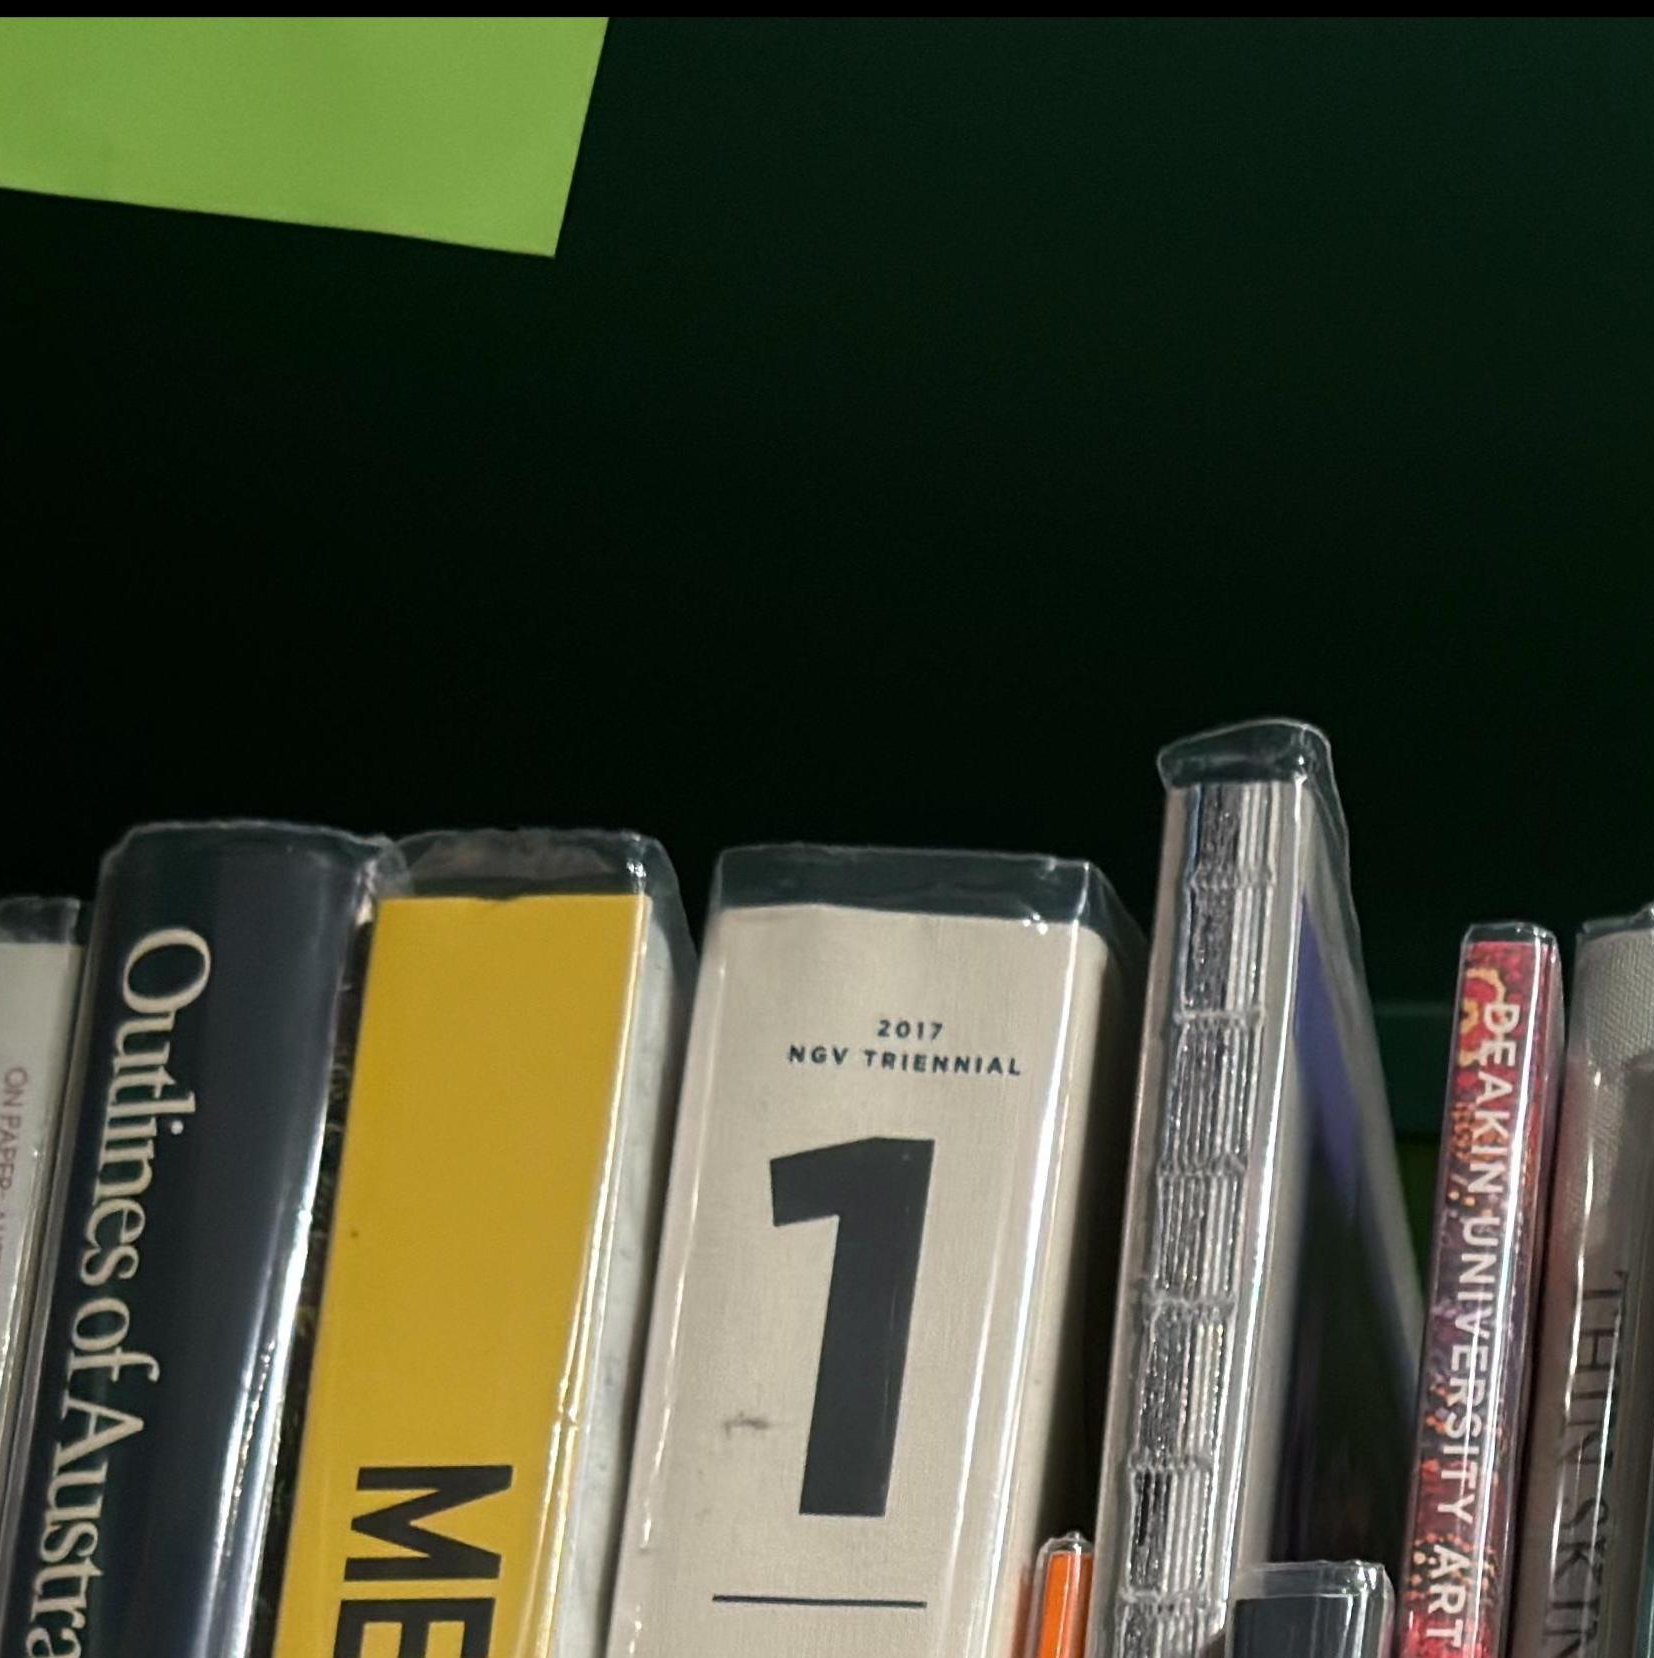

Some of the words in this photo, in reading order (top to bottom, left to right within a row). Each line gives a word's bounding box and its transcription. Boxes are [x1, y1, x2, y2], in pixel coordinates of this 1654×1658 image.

[70, 926, 212, 1285] Outlines
[788, 1045, 849, 1064] NGV
[862, 1050, 1024, 1077] TRIENNIAL
[875, 1019, 943, 1038] 2017
[1465, 1001, 1520, 1195] DEAKIN
[56, 1300, 155, 1380] of
[771, 1138, 934, 1516] 1
[1435, 1216, 1500, 1526] UNIVERSITY
[1555, 1270, 1629, 1474] THIN
[1424, 1544, 1471, 1649] ART
